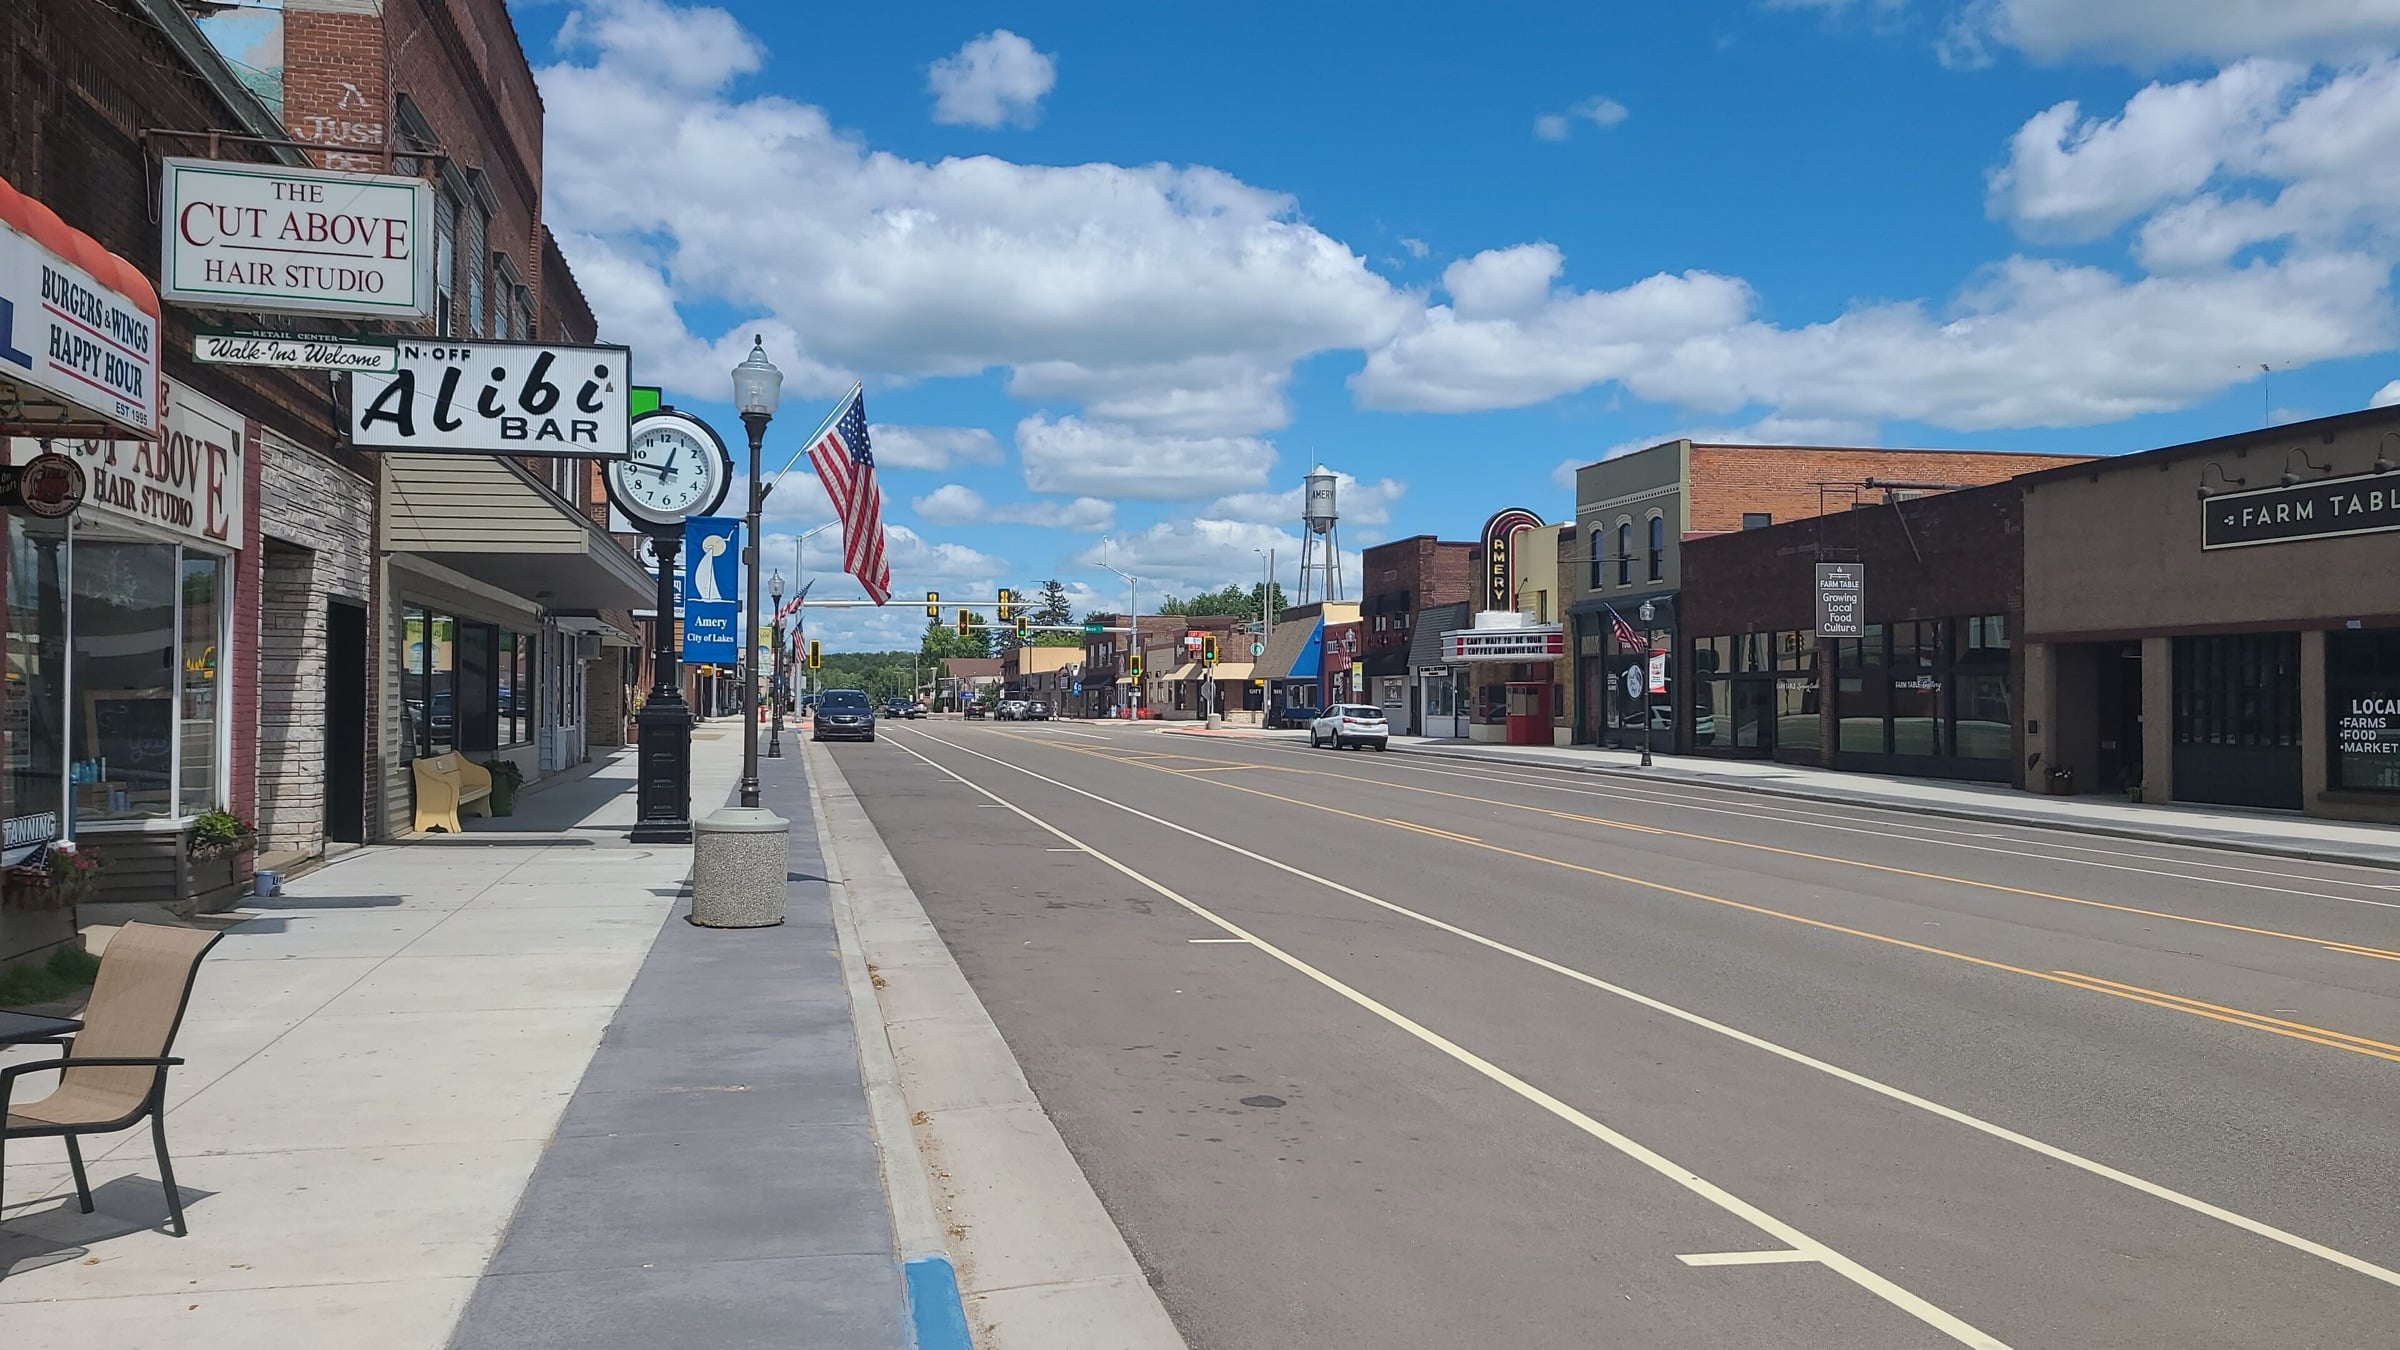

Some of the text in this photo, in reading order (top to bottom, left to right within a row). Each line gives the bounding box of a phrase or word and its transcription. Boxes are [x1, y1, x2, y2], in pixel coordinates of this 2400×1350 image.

[270, 181, 324, 203] THE
[180, 201, 410, 260] CUT ABOVE
[204, 258, 384, 293] HAIR STUDIO
[41, 264, 149, 354] BURGERS & WINGS
[252, 330, 339, 342] RETAIL CENTER
[207, 338, 382, 367] Walk-Ins Welcome
[49, 323, 102, 378] HAPPY
[104, 351, 143, 399] HOUR
[360, 350, 609, 437] Alibi
[115, 401, 148, 426] EST 1995
[500, 416, 599, 443] BAR
[660, 434, 672, 443] 12
[681, 439, 685, 447] 1
[633, 450, 647, 459] 10
[691, 450, 698, 459] 2
[628, 465, 638, 475] 9
[695, 465, 703, 475] 3
[132, 424, 230, 541] ABOVE
[634, 480, 642, 490] 8
[690, 481, 698, 491] 4
[93, 466, 138, 511] HAIR
[141, 485, 194, 528] STUDIO
[646, 491, 654, 500] 7
[680, 492, 687, 502] 5
[1312, 489, 1334, 499] AMERY
[662, 495, 671, 505] 6
[2242, 500, 2313, 527] FARM
[1493, 538, 1505, 600] AMERY
[1820, 580, 1859, 588] FARM TABLE
[1822, 592, 1857, 604] Growing
[1828, 603, 1852, 612] Local
[694, 616, 728, 630] Amery
[1830, 613, 1852, 622] Food
[1824, 623, 1857, 632] Culture
[687, 632, 734, 644] City of Lakes
[1467, 647, 1493, 655] COFFEE
[1506, 646, 1526, 654] MOVIE
[1526, 645, 1543, 654] DATE
[2352, 699, 2400, 715] LOCA
[2344, 717, 2387, 728] FARMS
[2344, 730, 2377, 741] FOOD
[3, 811, 56, 849] TANNING
